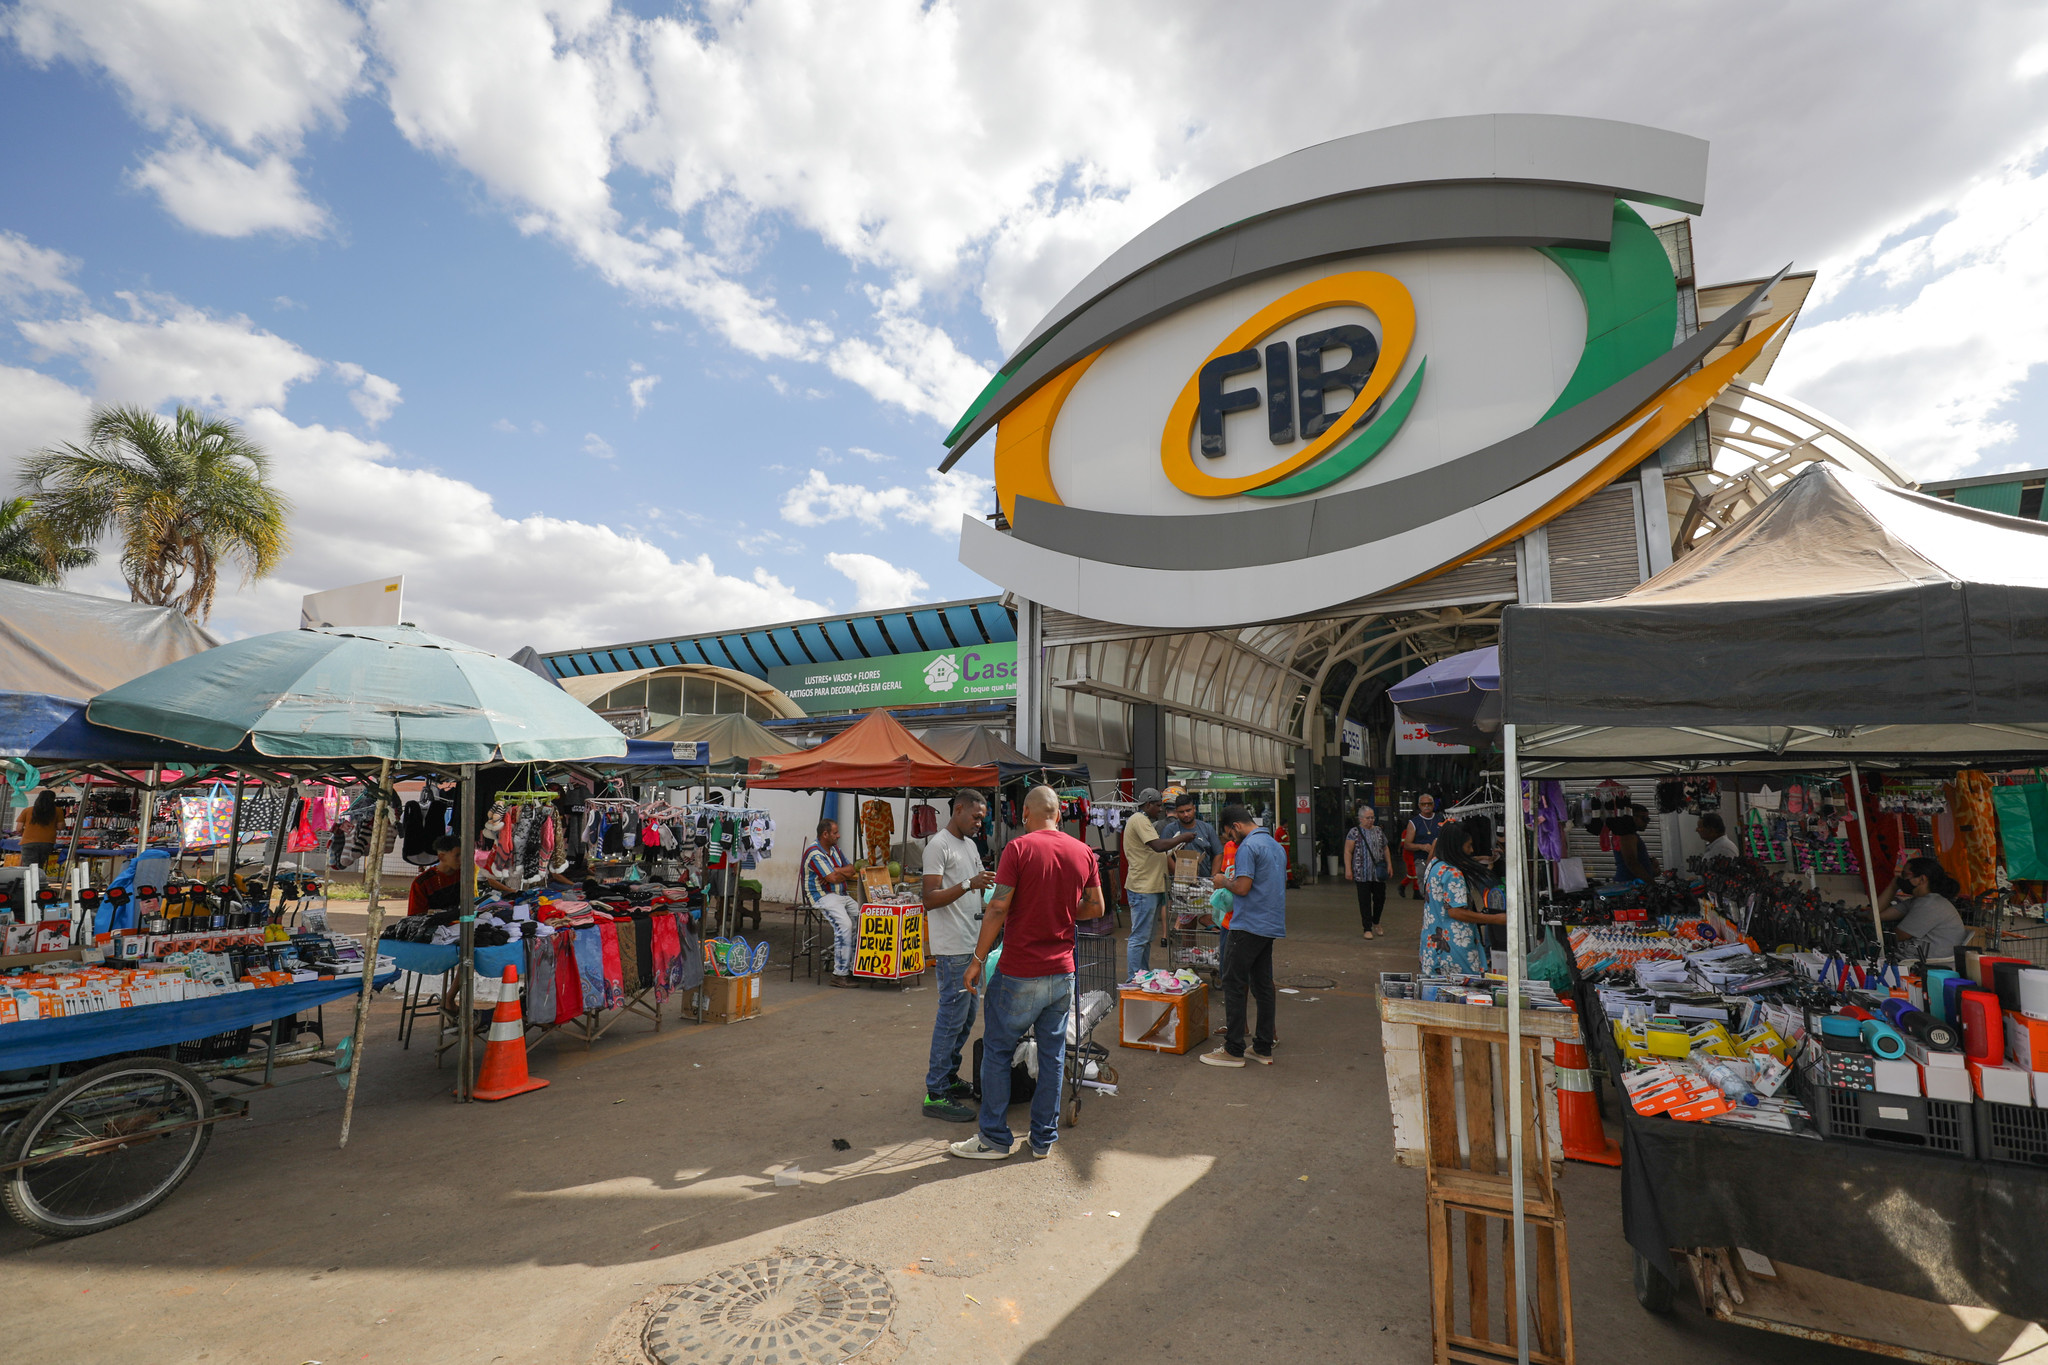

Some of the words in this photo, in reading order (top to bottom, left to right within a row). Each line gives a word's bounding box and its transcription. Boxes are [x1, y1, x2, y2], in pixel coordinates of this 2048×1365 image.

[1199, 324, 1382, 459] FIB
[833, 673, 852, 682] VASOS
[858, 670, 880, 680] FLORES
[789, 688, 813, 698] ARTIGOS
[814, 686, 829, 696] PARA
[830, 682, 870, 695] DECORAÇÕES
[871, 682, 881, 691] EM
[882, 680, 902, 690] GERAL
[991, 684, 1004, 692] que
[865, 908, 893, 916] OFERTA
[860, 936, 893, 951] DRIVE
[1932, 1030, 1949, 1042] JBL
